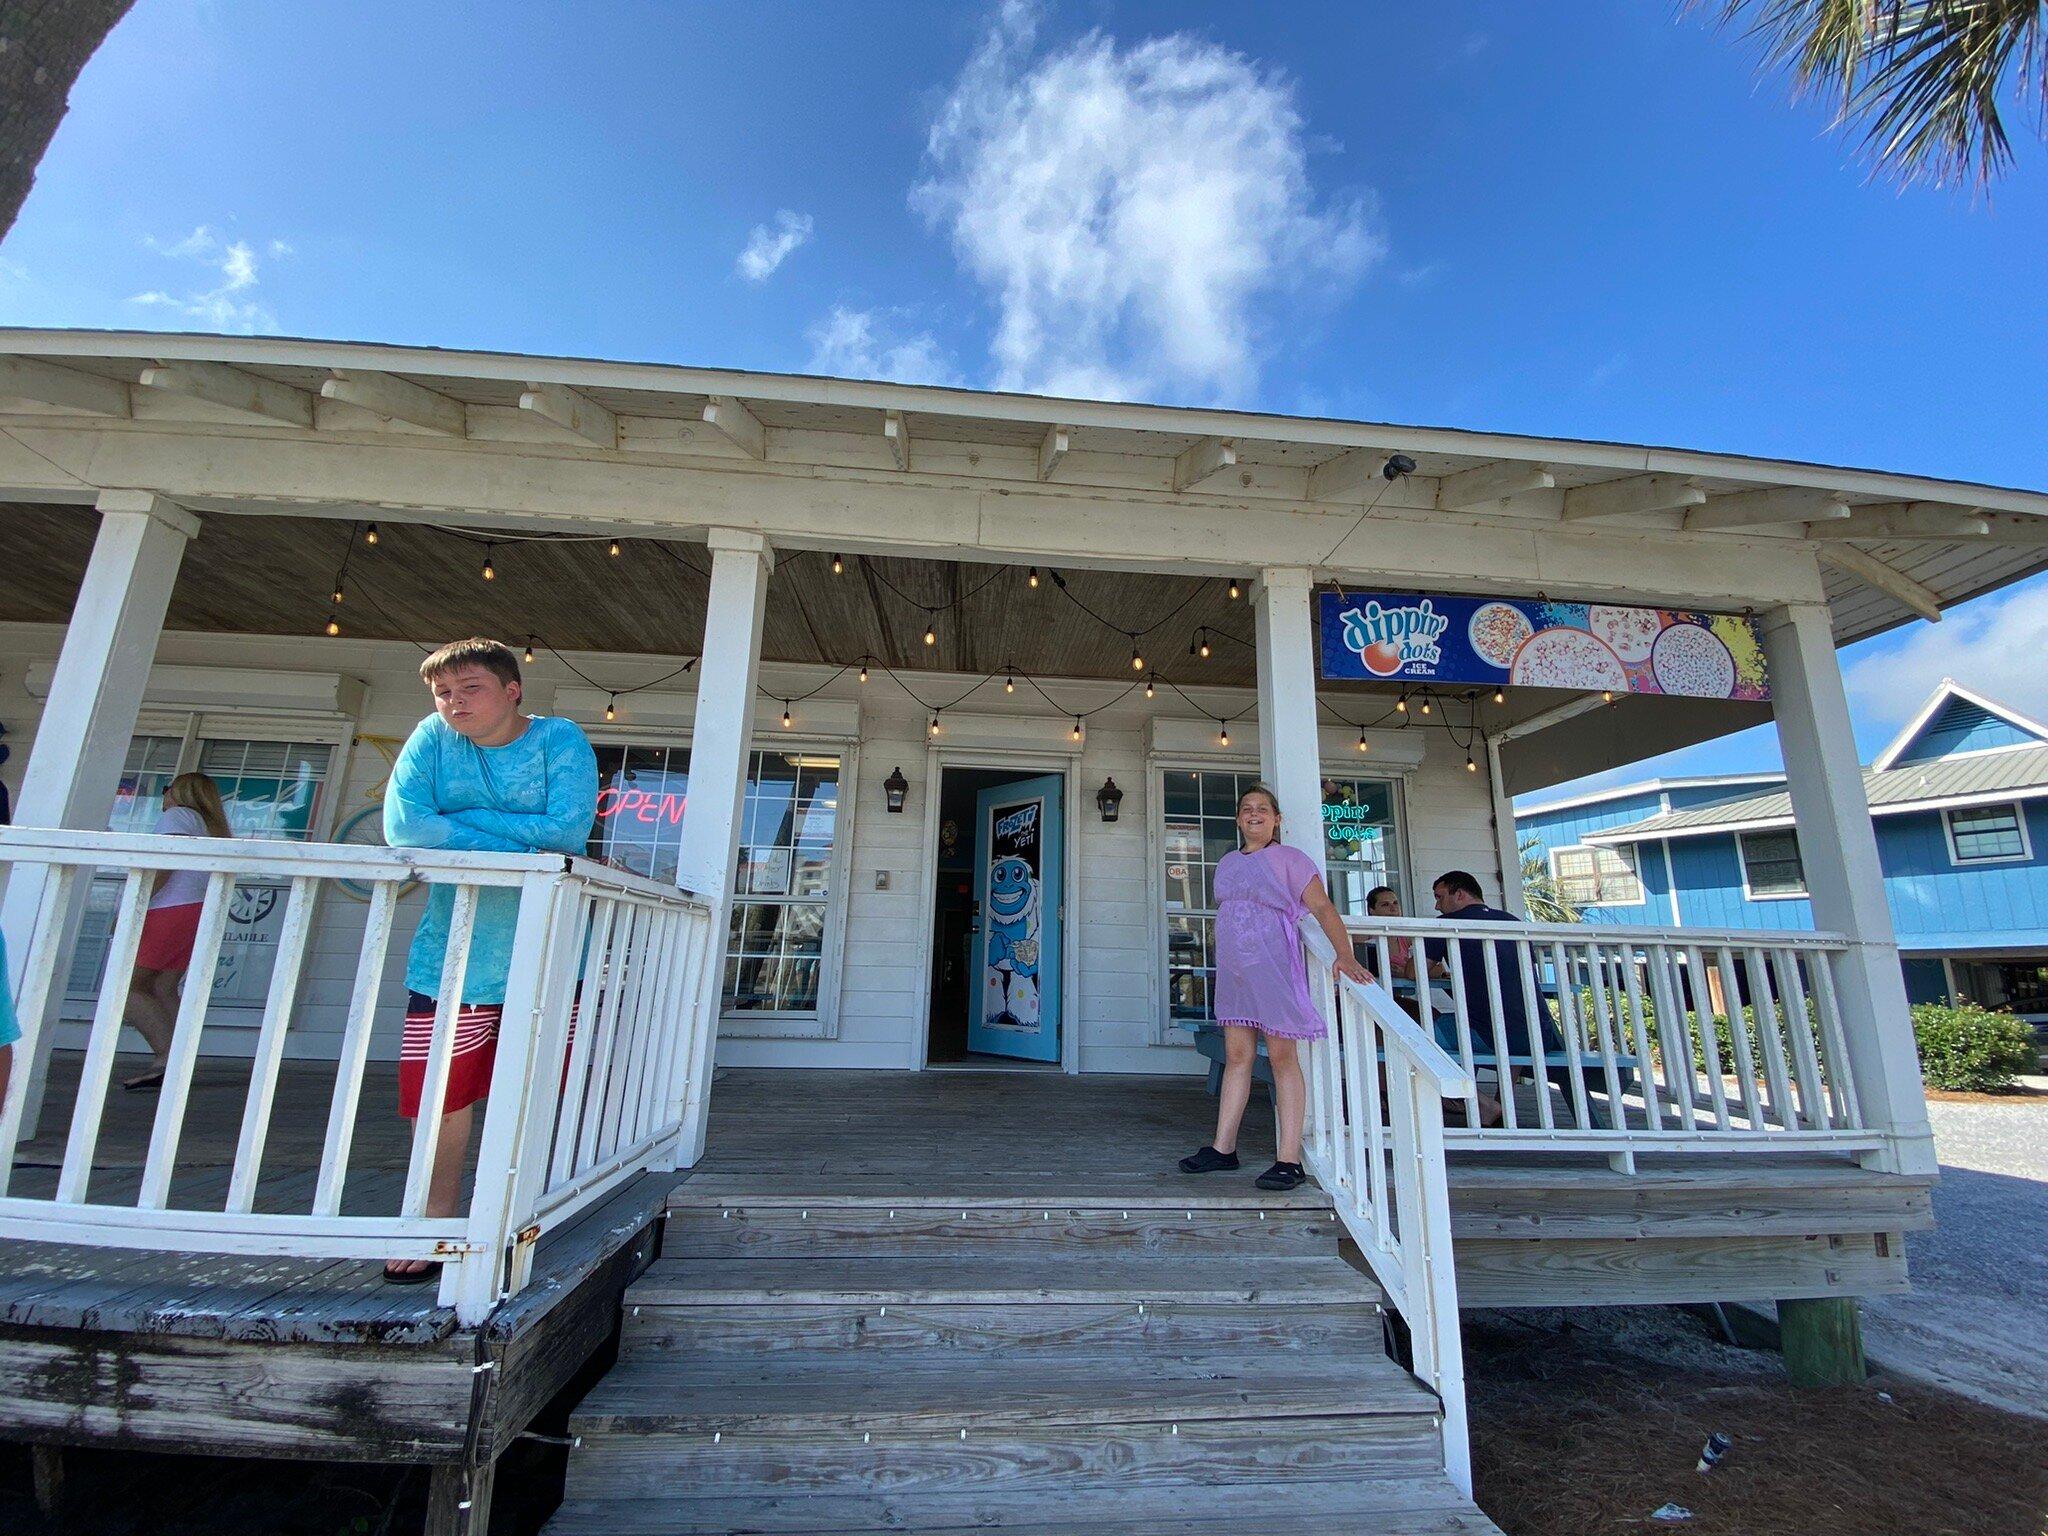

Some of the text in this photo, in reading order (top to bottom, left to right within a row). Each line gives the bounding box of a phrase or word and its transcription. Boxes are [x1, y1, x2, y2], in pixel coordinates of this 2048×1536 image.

[1341, 601, 1447, 651] dippin'
[1399, 640, 1439, 662] dots
[1404, 667, 1436, 675] CREAM
[596, 788, 689, 824] OPEN
[1321, 799, 1370, 821] ppin'
